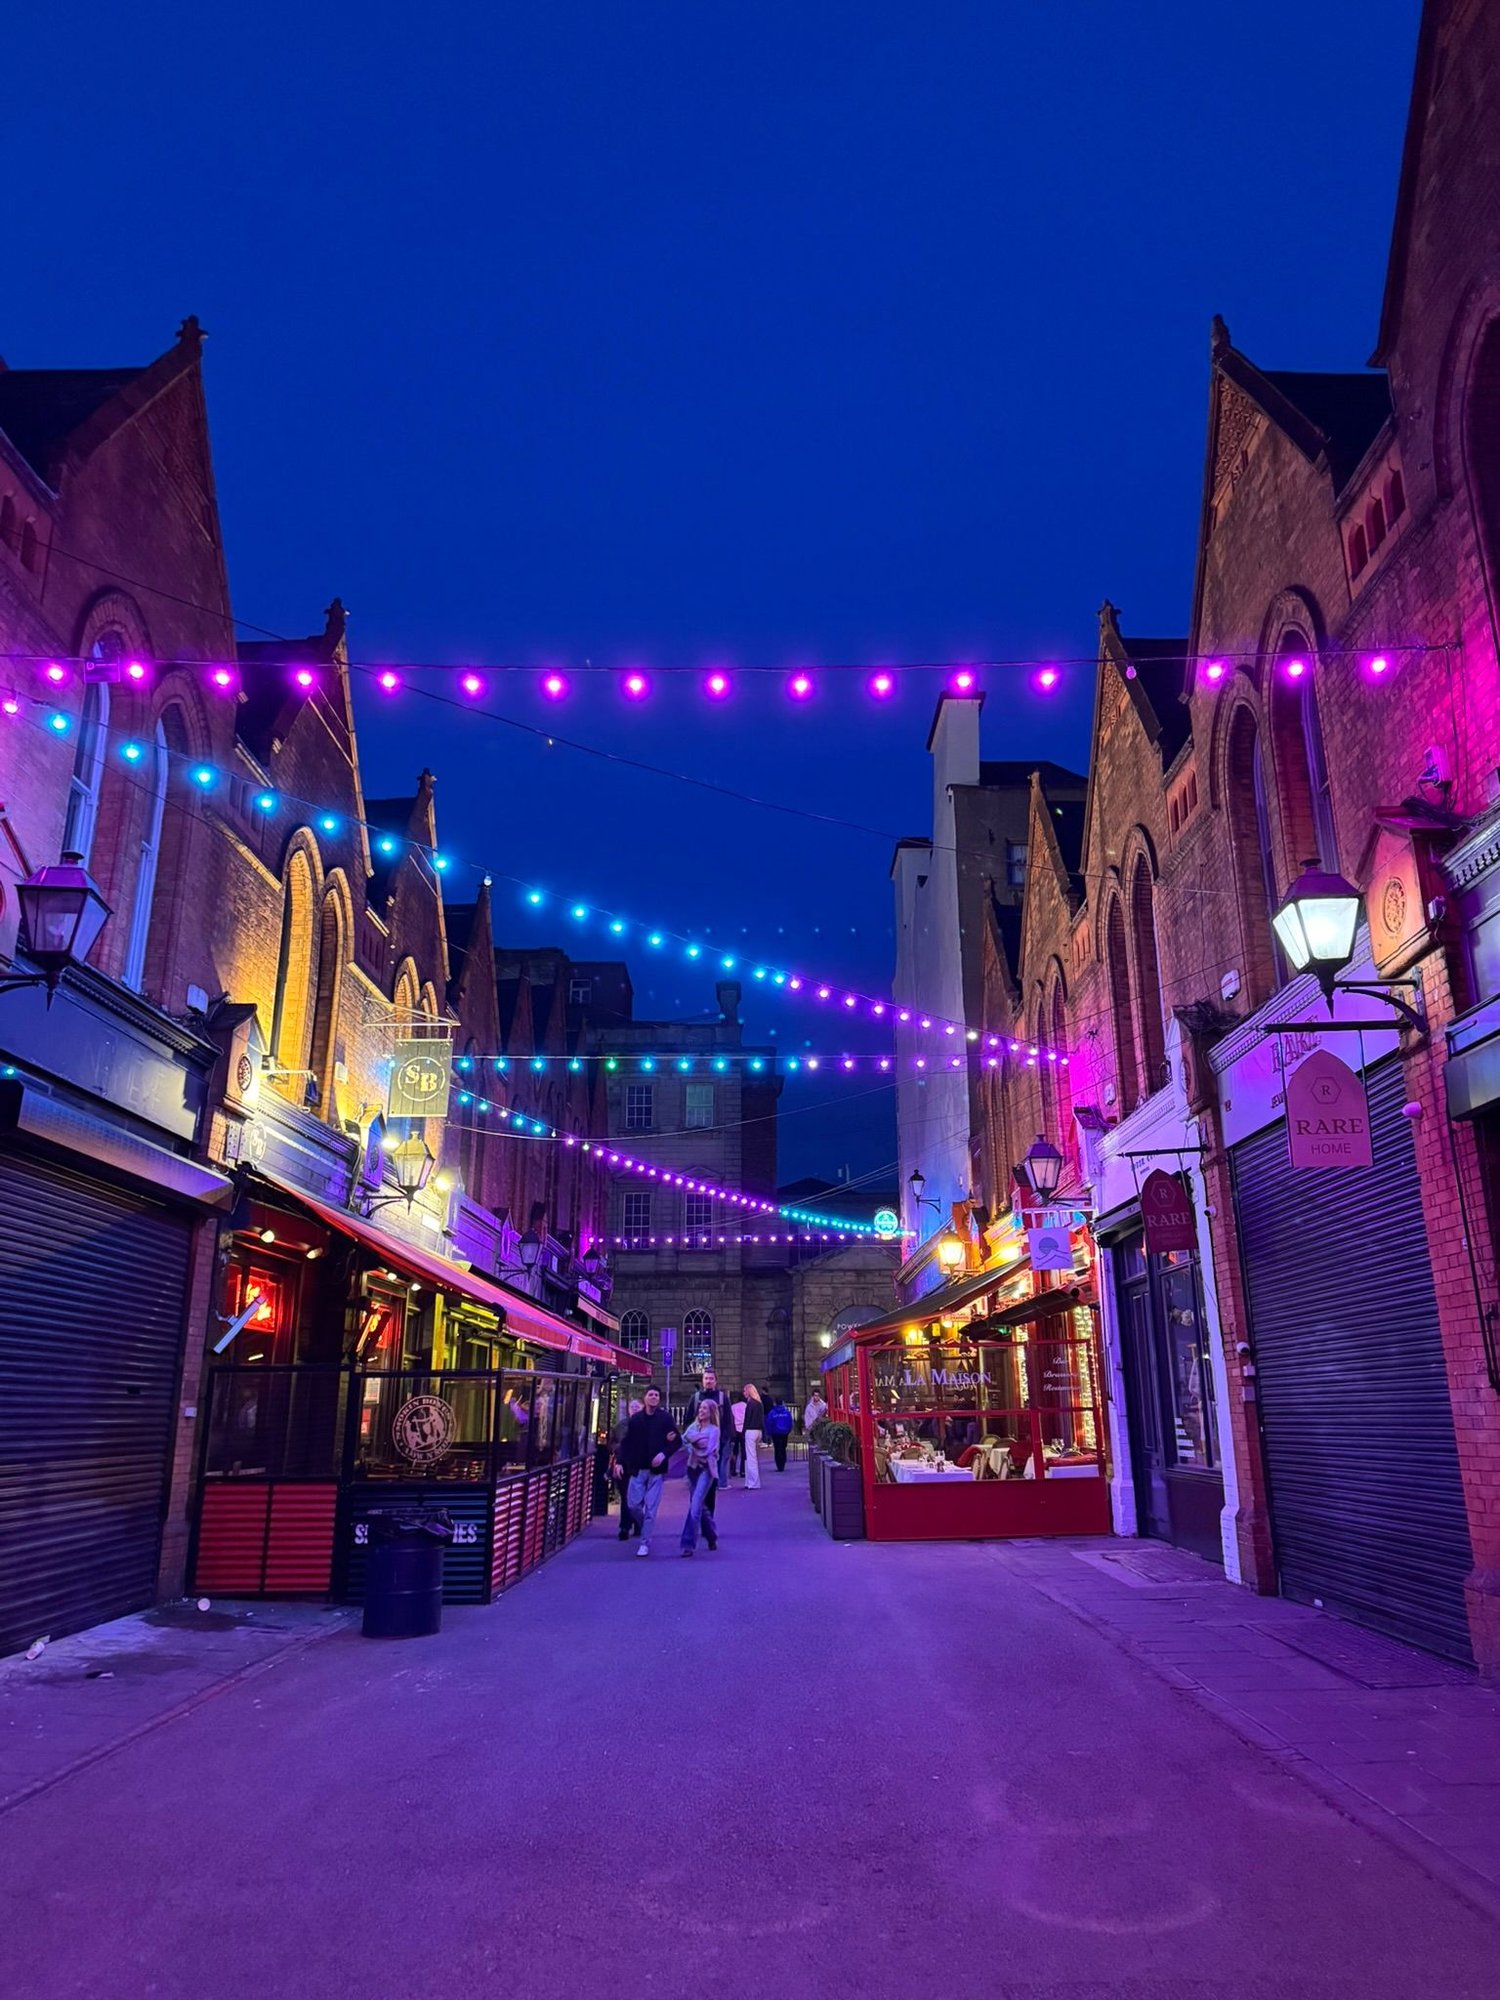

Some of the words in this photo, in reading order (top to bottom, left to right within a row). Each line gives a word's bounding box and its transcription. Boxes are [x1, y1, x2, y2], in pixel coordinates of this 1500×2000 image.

[405, 1065, 438, 1092] SB
[1321, 1085, 1331, 1096] R
[1296, 1119, 1364, 1135] RARE
[1311, 1143, 1352, 1155] HOME
[1159, 1188, 1169, 1199] R
[1147, 1211, 1191, 1228] RARE
